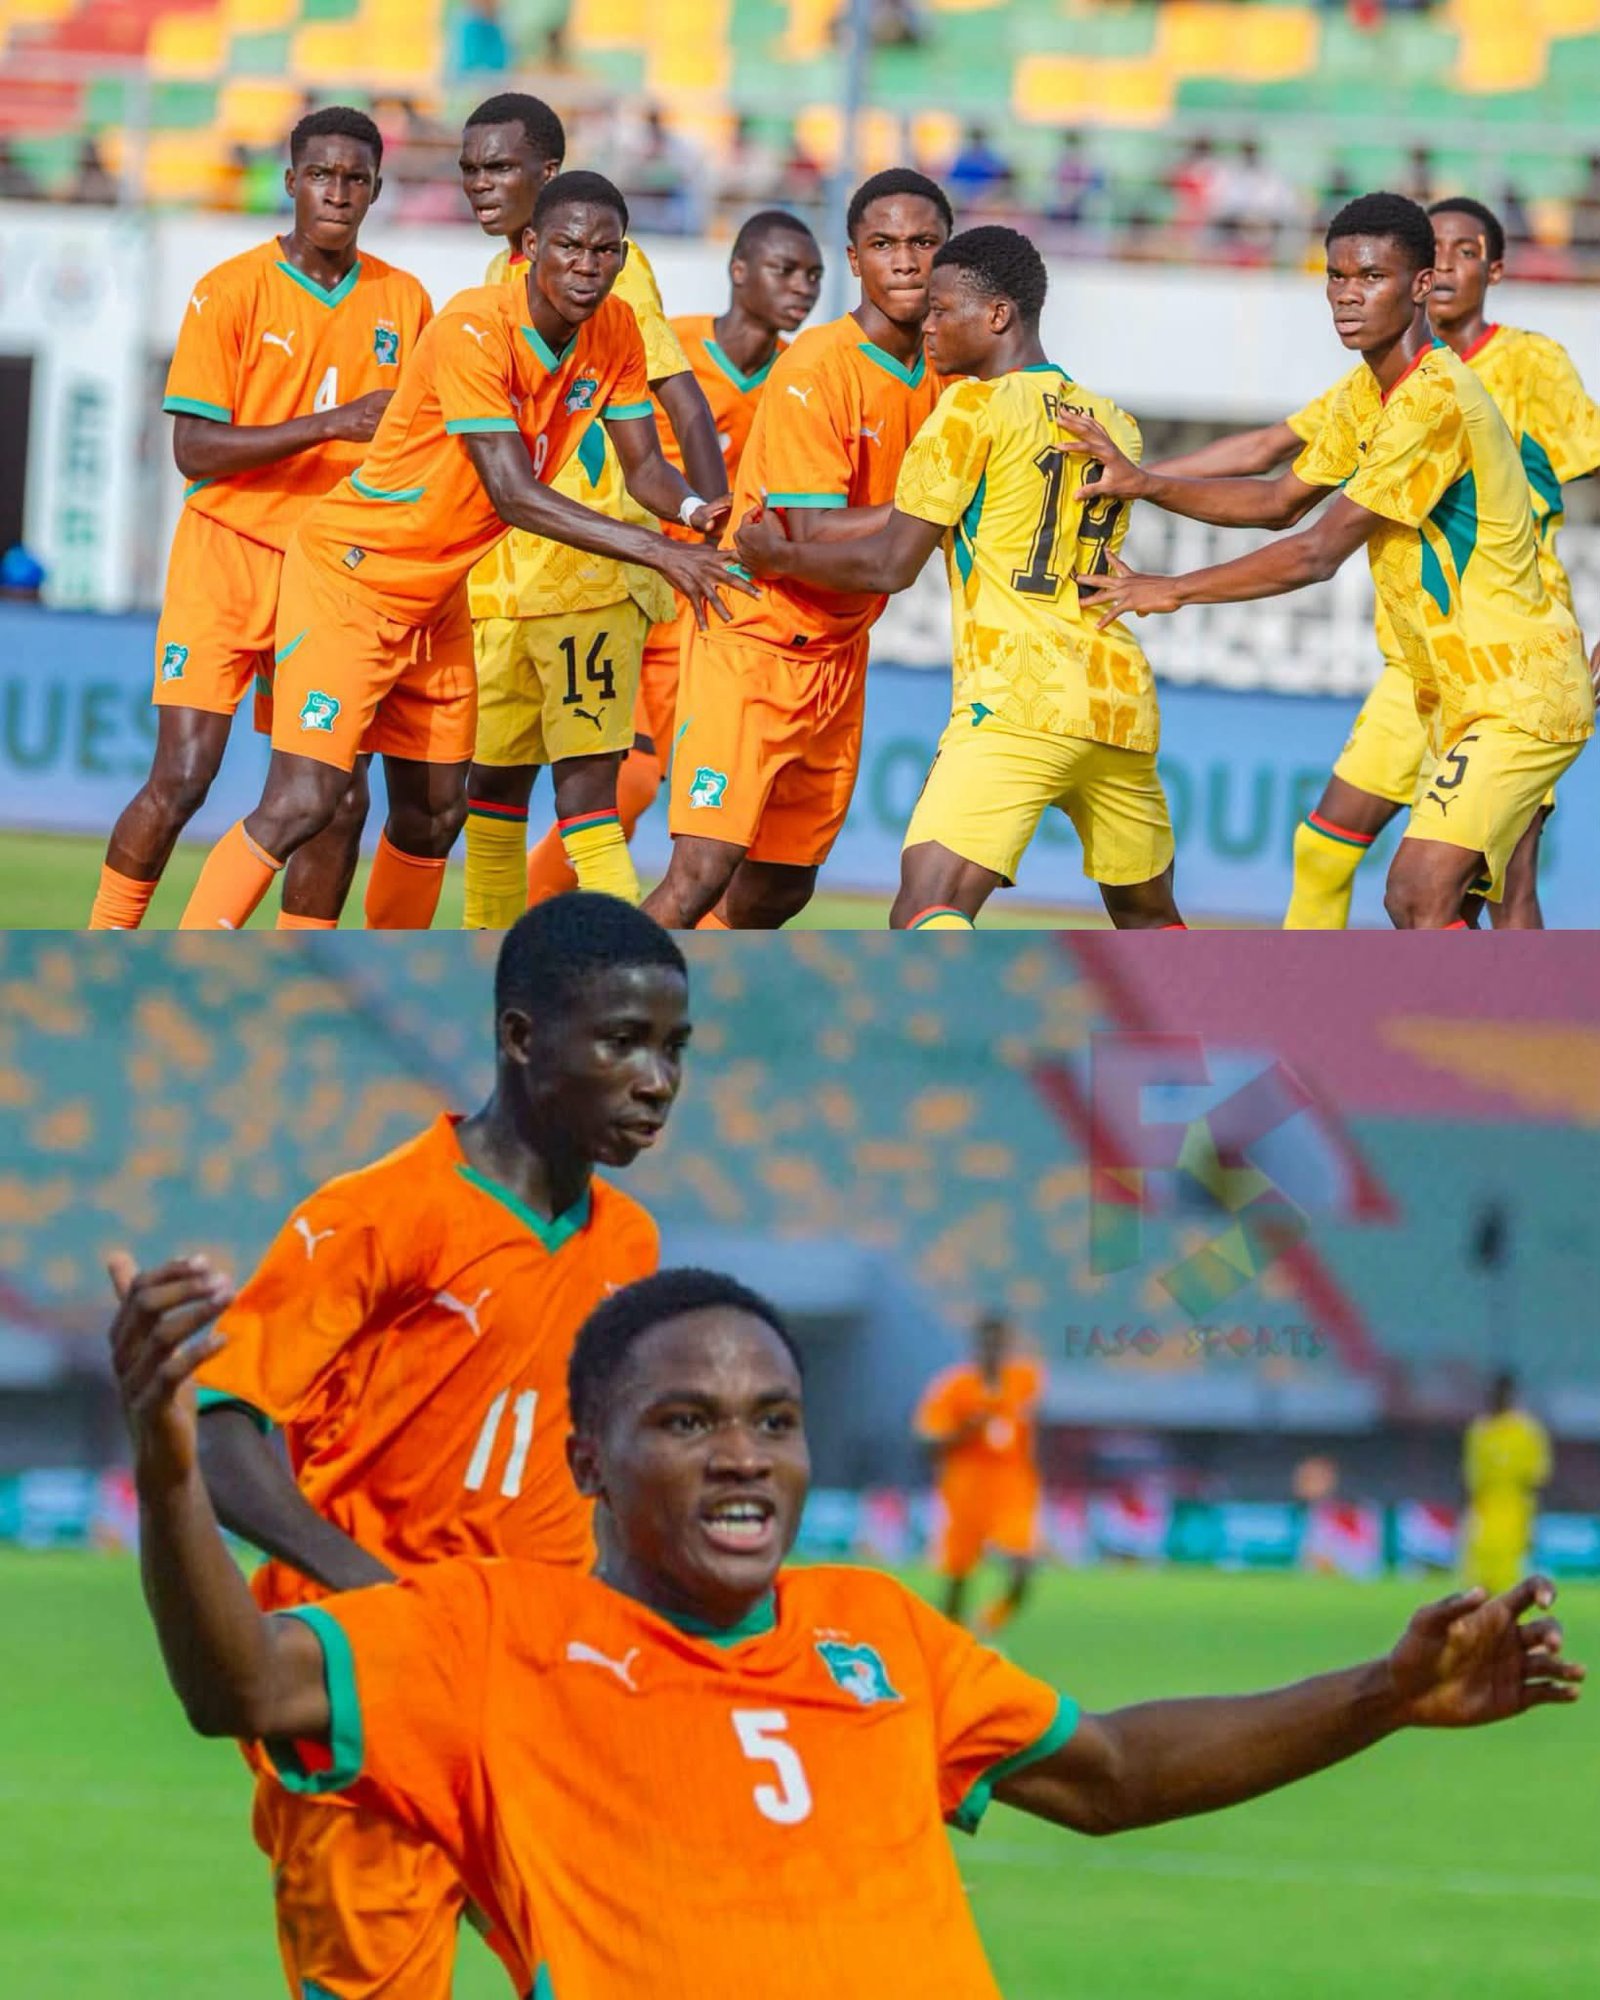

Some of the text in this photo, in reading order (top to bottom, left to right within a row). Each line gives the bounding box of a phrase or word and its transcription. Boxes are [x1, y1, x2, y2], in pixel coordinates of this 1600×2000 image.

[313, 366, 338, 414] 4
[558, 631, 616, 705] 14
[1435, 735, 1481, 790] 5
[463, 1388, 539, 1498] 11
[731, 1708, 812, 1824] 5
